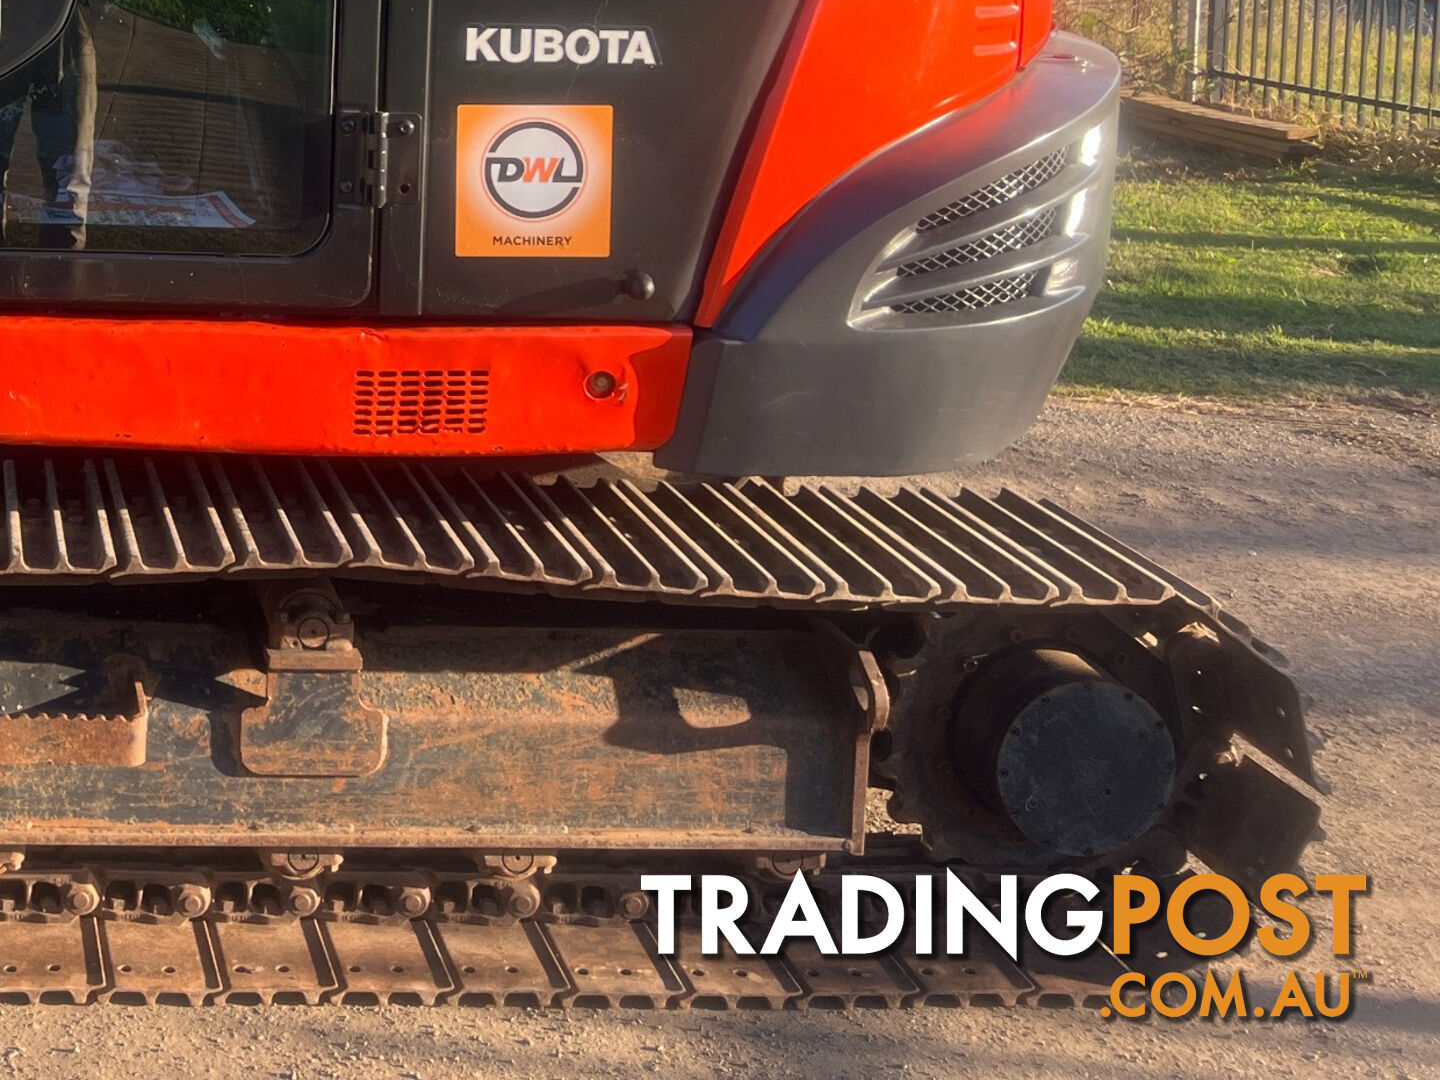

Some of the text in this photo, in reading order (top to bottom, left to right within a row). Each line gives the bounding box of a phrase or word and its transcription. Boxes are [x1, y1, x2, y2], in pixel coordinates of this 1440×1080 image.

[465, 27, 656, 66] KUBOTA
[486, 156, 583, 184] DWL
[492, 235, 573, 247] MACHINERY
